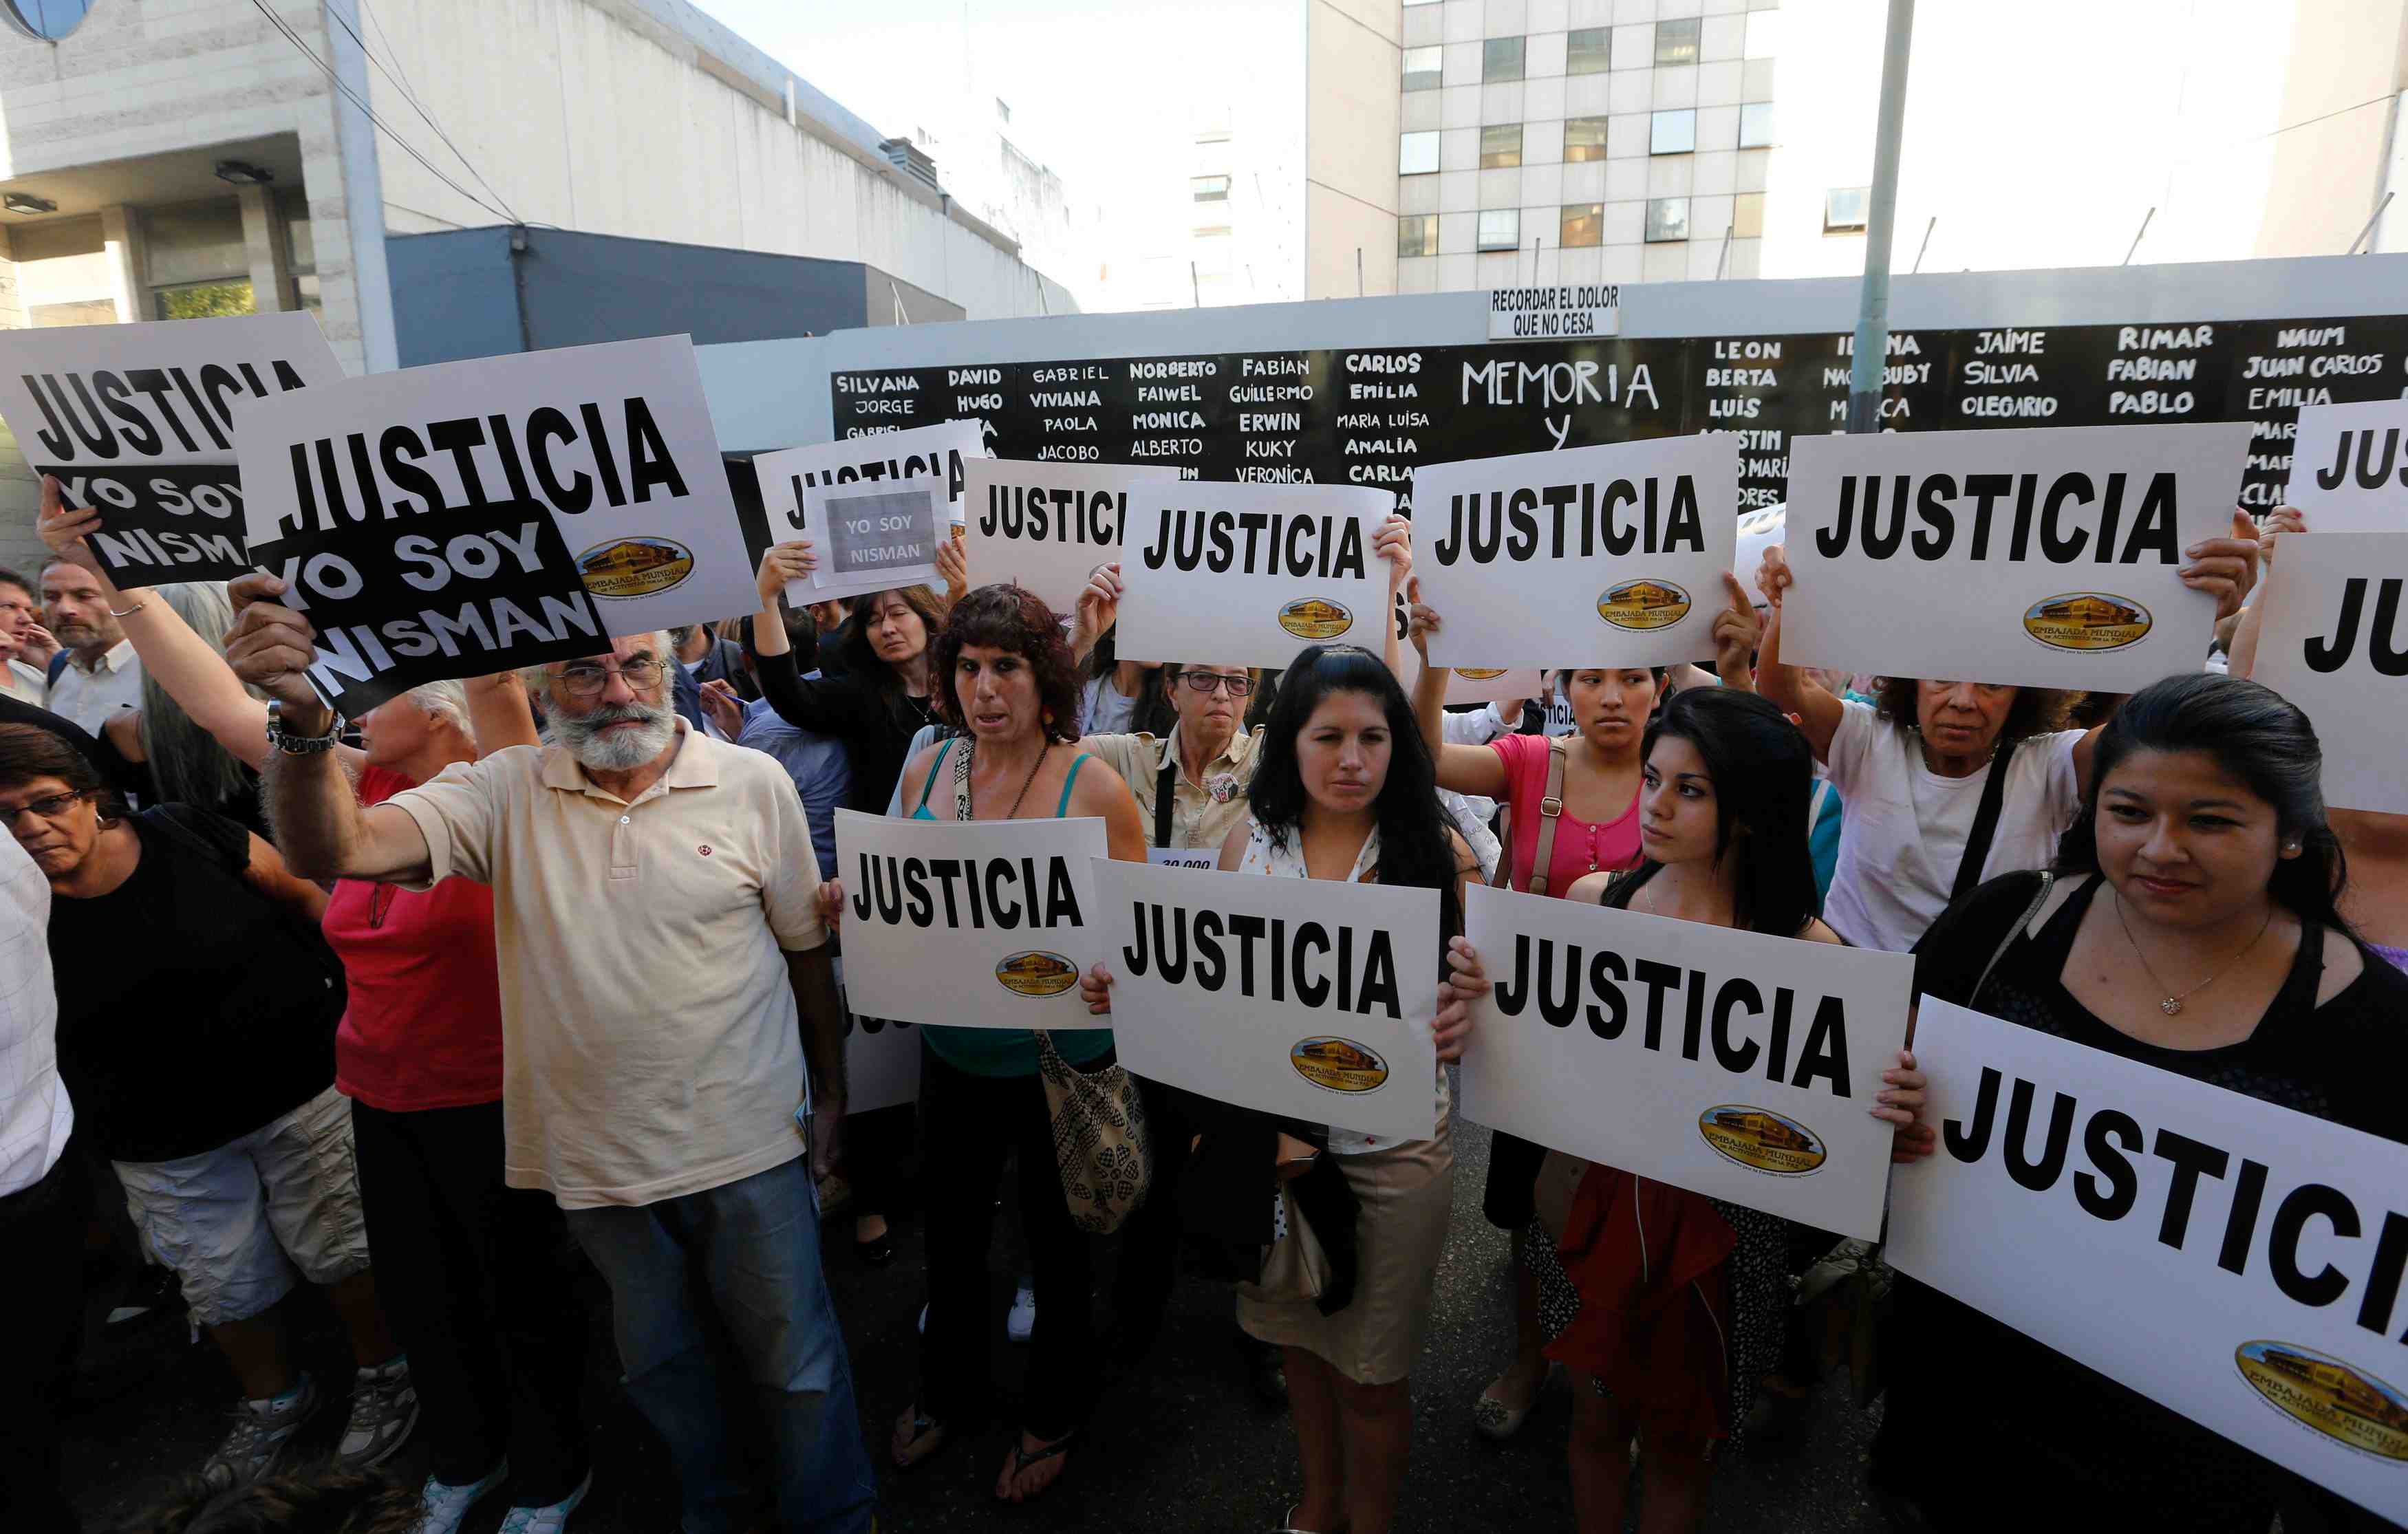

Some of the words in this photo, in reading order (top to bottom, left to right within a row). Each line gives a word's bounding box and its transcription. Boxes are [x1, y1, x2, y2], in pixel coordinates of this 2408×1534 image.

[1492, 288, 1556, 312] RECORDAR
[1560, 287, 1573, 310] EL
[1578, 286, 1619, 309] DOLOR
[1514, 314, 1538, 336] QUE
[1542, 313, 1558, 335] NO
[1562, 312, 1594, 334] CESA
[1837, 335, 1921, 356] ILNA
[1975, 327, 2045, 354] JAIME
[2118, 325, 2213, 352] RIMAR
[2276, 327, 2345, 348] NAUM
[1714, 341, 1782, 360] LEON
[1129, 360, 1217, 380] NORBERTO
[1242, 356, 1310, 376] FABIAN
[1345, 352, 1422, 374] CARLOS
[2107, 357, 2196, 381] FABIAN
[2242, 356, 2305, 378] JUAN
[2308, 354, 2384, 378] CARLOS
[836, 376, 920, 393] SILVANA
[948, 368, 1002, 387] DAVID
[1032, 366, 1109, 382] GABRIEL
[1462, 359, 1659, 410] MEMORIA
[1706, 368, 1778, 387] BERTA
[1964, 363, 2039, 385] SILVIA
[1029, 390, 1101, 407] VIVIANA
[1137, 385, 1202, 402] FAIWEL
[1229, 383, 1313, 403] GUILLERMO
[1350, 382, 1419, 400] EMILIA
[2248, 387, 2333, 410] EMILIA
[855, 400, 914, 413] JORGE
[957, 393, 1003, 412] HUGO
[1709, 395, 1762, 418] LUIS
[1961, 396, 2058, 417] OLEGARIO
[2109, 390, 2194, 414] PABLO
[1044, 416, 1098, 432] PAOLA
[1132, 411, 1205, 430] MONICA
[1239, 413, 1301, 432] ERWIN
[1038, 446, 1099, 460] JACOBO
[1130, 438, 1203, 457] ALBERTO
[1246, 440, 1296, 457] KUKY
[1344, 437, 1417, 455] ANALIA
[278, 397, 689, 537] JUSTICIA
[1236, 464, 1315, 484] VERONICA
[58, 476, 137, 510] YO
[149, 478, 243, 519] SO
[846, 519, 870, 534] YO
[879, 515, 913, 532] SOY
[980, 484, 1127, 546] JUSTICI
[1434, 475, 1705, 566] JUSTICIA
[1815, 472, 2180, 565] JUSTICIA
[850, 543, 921, 563] NISMAN
[1143, 509, 1366, 580] JUSTICIA
[255, 552, 363, 611] YO
[394, 521, 544, 591] SOY
[2033, 626, 2087, 636] EMBAJADA
[2091, 629, 2138, 638] MUNDIAL
[312, 590, 601, 698] NISMAN
[852, 852, 1084, 929] JUSTICIA
[1122, 901, 1402, 1019] JUSTICIA
[1494, 933, 1851, 1099] JUSTICIA
[1708, 1132, 1762, 1154] EMBAJADA
[1766, 1148, 1812, 1167] MUNDIAL
[1943, 1066, 2408, 1346] JUSTICI
